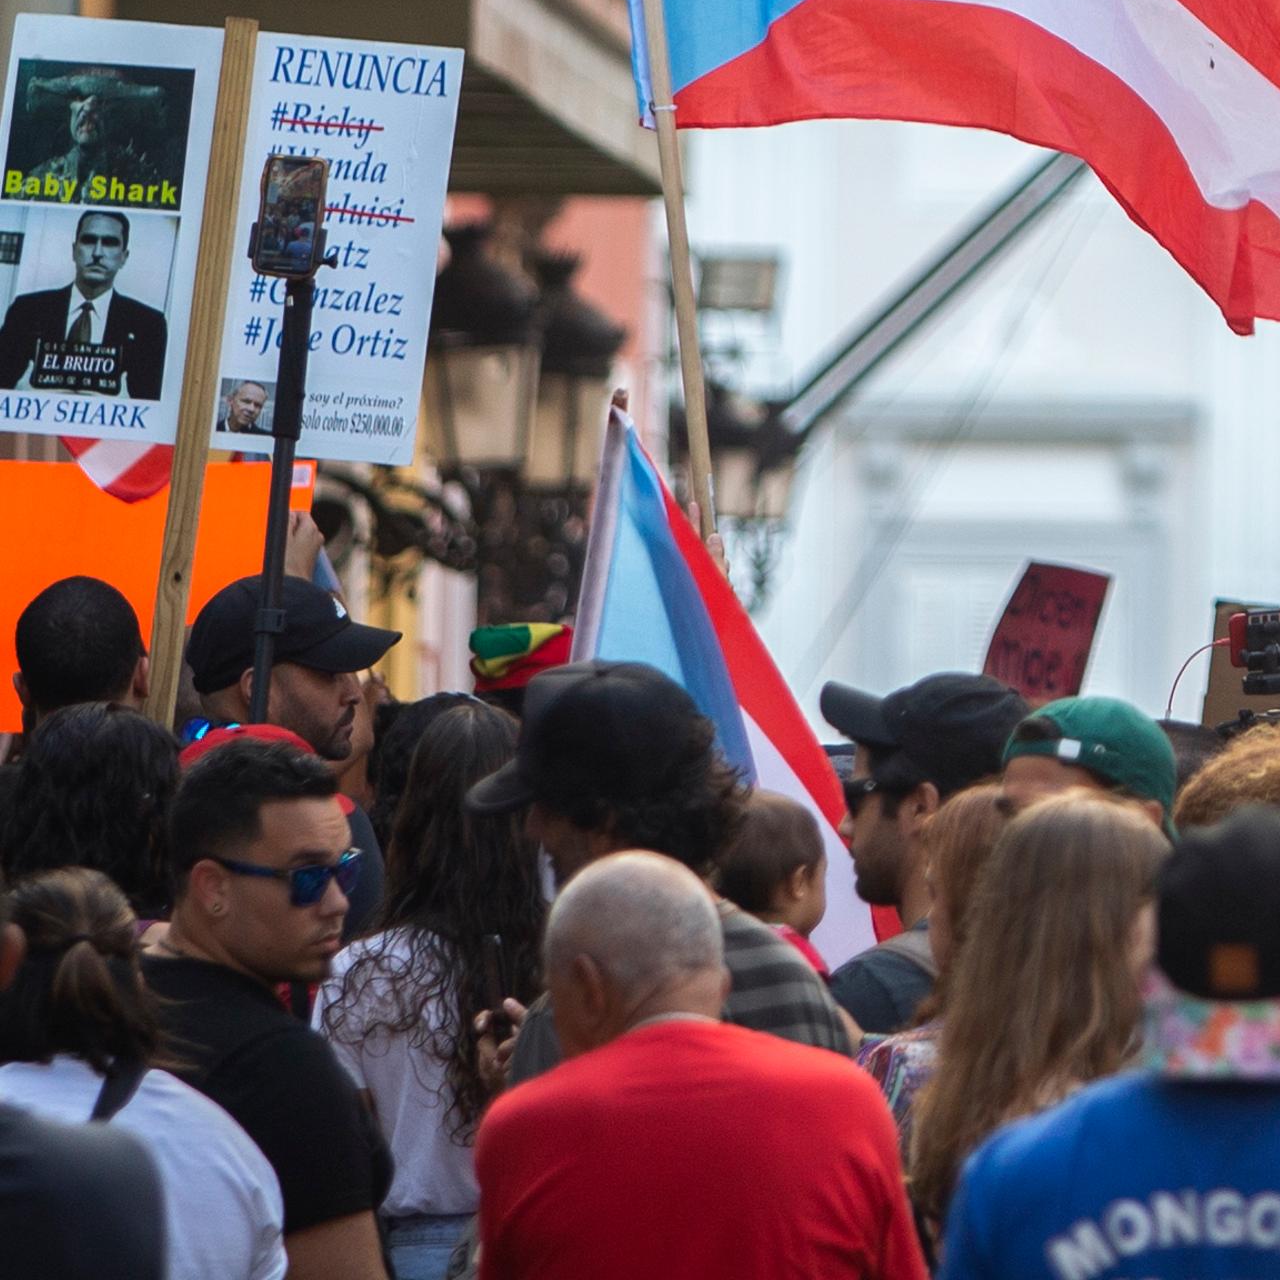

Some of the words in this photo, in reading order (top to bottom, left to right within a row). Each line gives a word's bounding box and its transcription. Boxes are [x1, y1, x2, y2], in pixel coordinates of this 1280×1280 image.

[269, 46, 448, 97] RENUNCIA
[271, 101, 376, 149] #Ricky
[5, 170, 77, 203] Baby
[90, 175, 177, 204] Shark
[250, 273, 404, 316] #Gnzalez
[331, 324, 409, 360] Ortiz
[42, 354, 60, 370] EL
[63, 355, 115, 373] BRUTO
[54, 400, 150, 429] SHARK
[309, 392, 331, 408] soy
[333, 392, 344, 405] el
[322, 410, 349, 432] cobro
